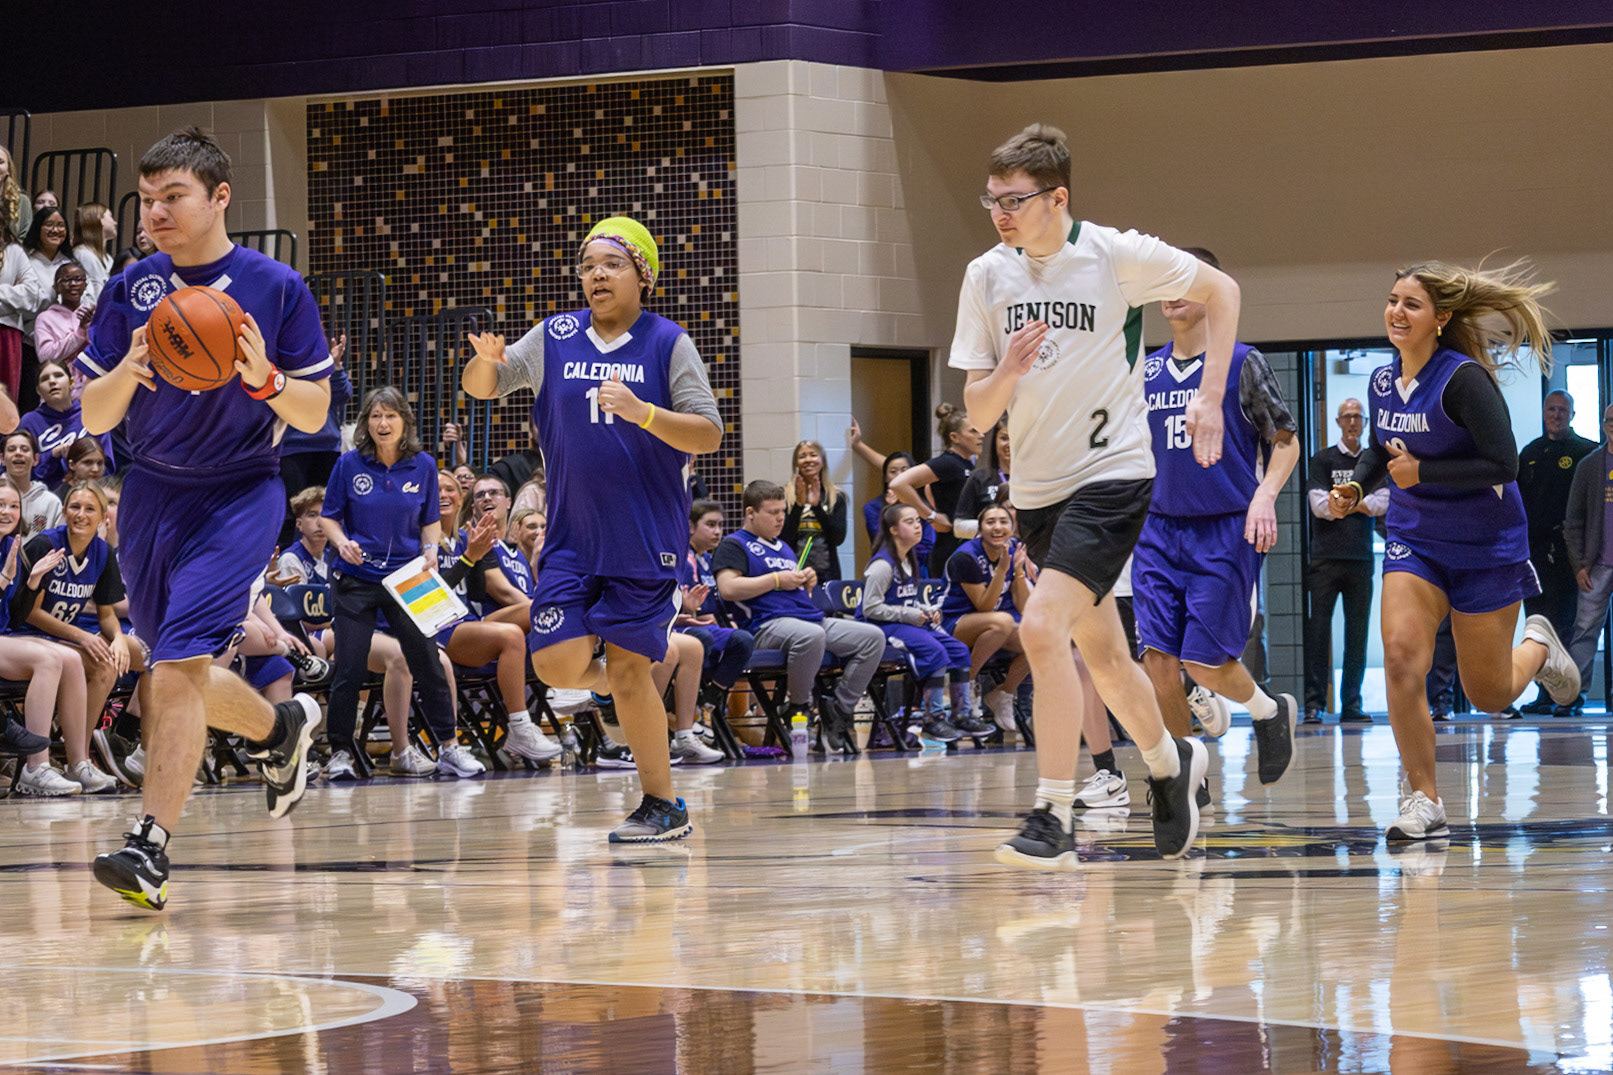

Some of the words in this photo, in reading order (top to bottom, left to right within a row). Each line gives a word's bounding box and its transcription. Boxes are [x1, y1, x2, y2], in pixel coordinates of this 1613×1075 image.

[1004, 301, 1096, 334] JENISON
[563, 361, 645, 383] CALEDONIA
[1149, 388, 1199, 411] CALEDO
[1089, 408, 1109, 449] 2
[1164, 414, 1193, 450] 15
[1376, 407, 1430, 433] CALEDONIA
[402, 481, 420, 494] Cal
[48, 579, 96, 599] CALEDONI
[842, 585, 863, 609] Cal
[50, 601, 81, 624] 63
[303, 590, 329, 617] Cal
